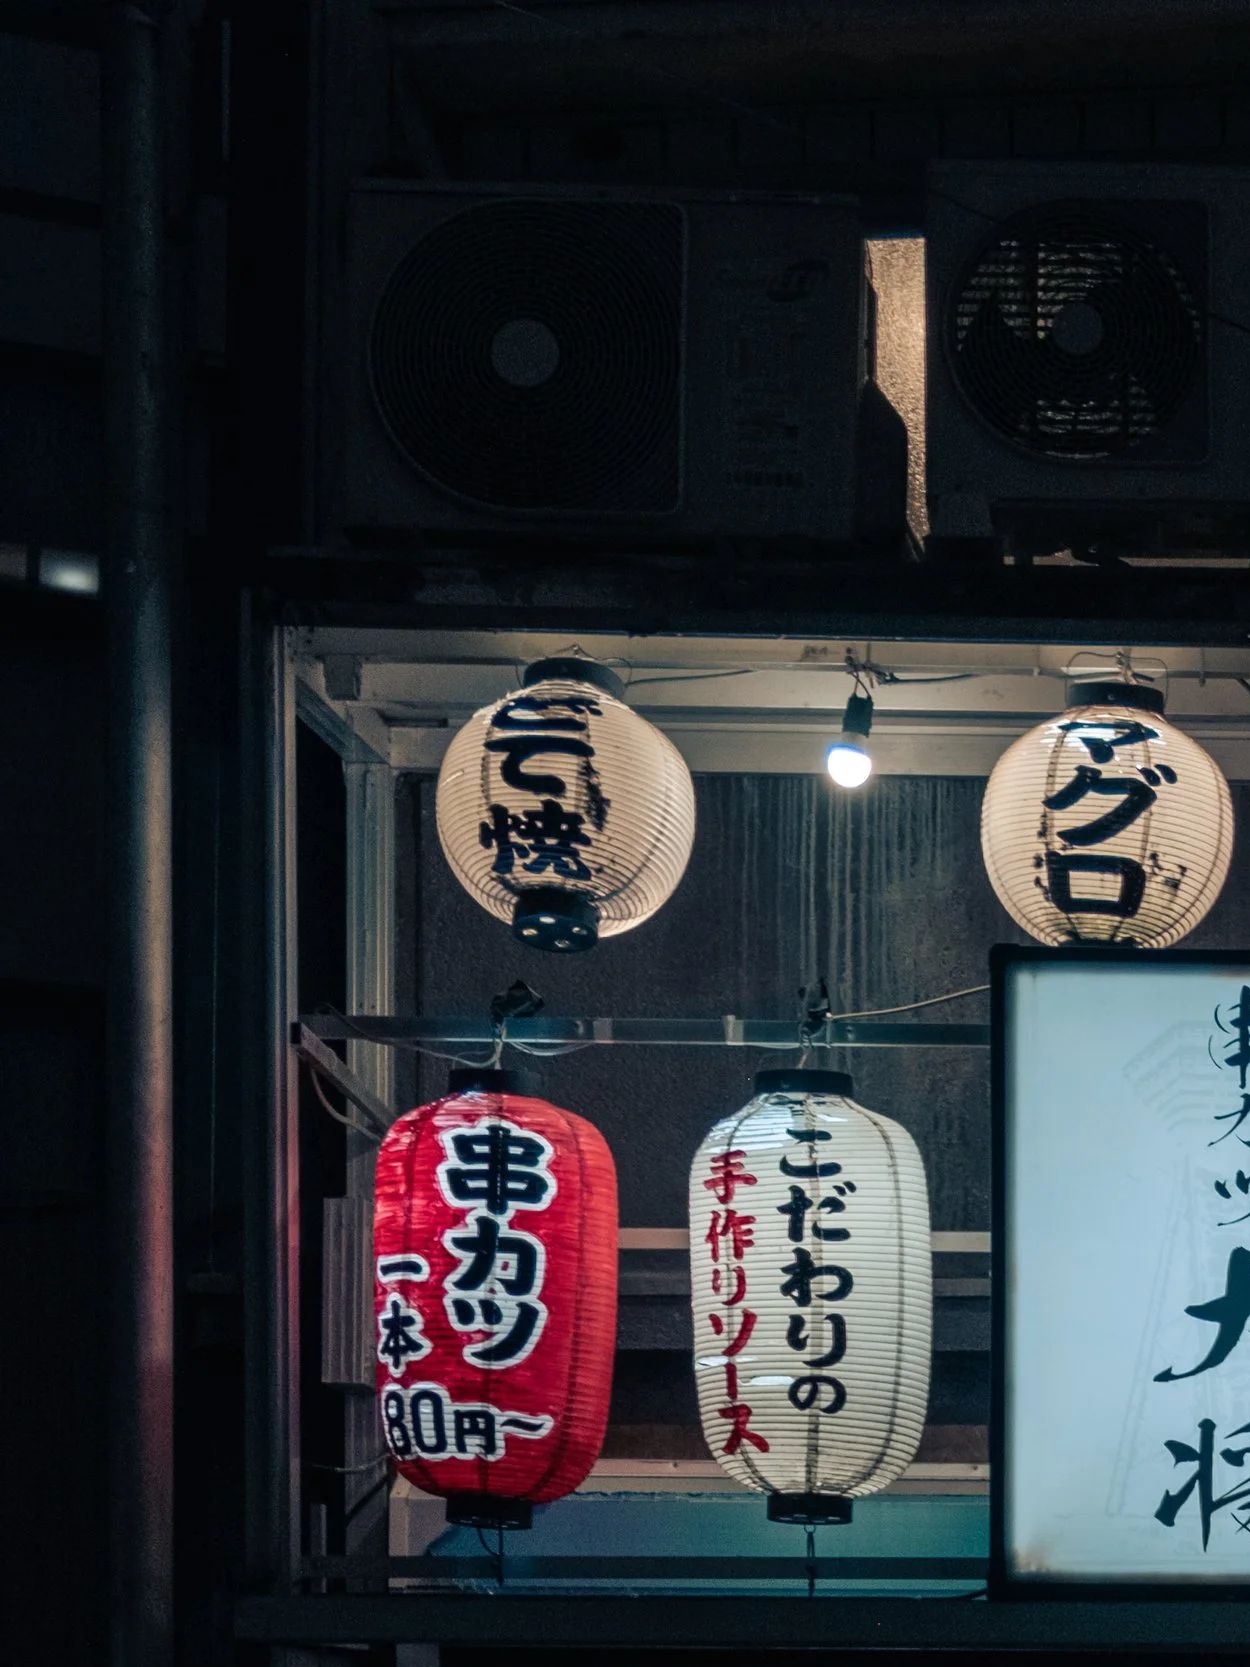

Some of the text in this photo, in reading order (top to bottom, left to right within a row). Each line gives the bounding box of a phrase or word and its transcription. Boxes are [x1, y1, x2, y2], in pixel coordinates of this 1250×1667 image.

[1042, 720, 1178, 918] マグロ
[446, 1125, 549, 1364] 串カツ
[703, 1149, 770, 1455] 手作りソース
[777, 1127, 857, 1415] こだわりの
